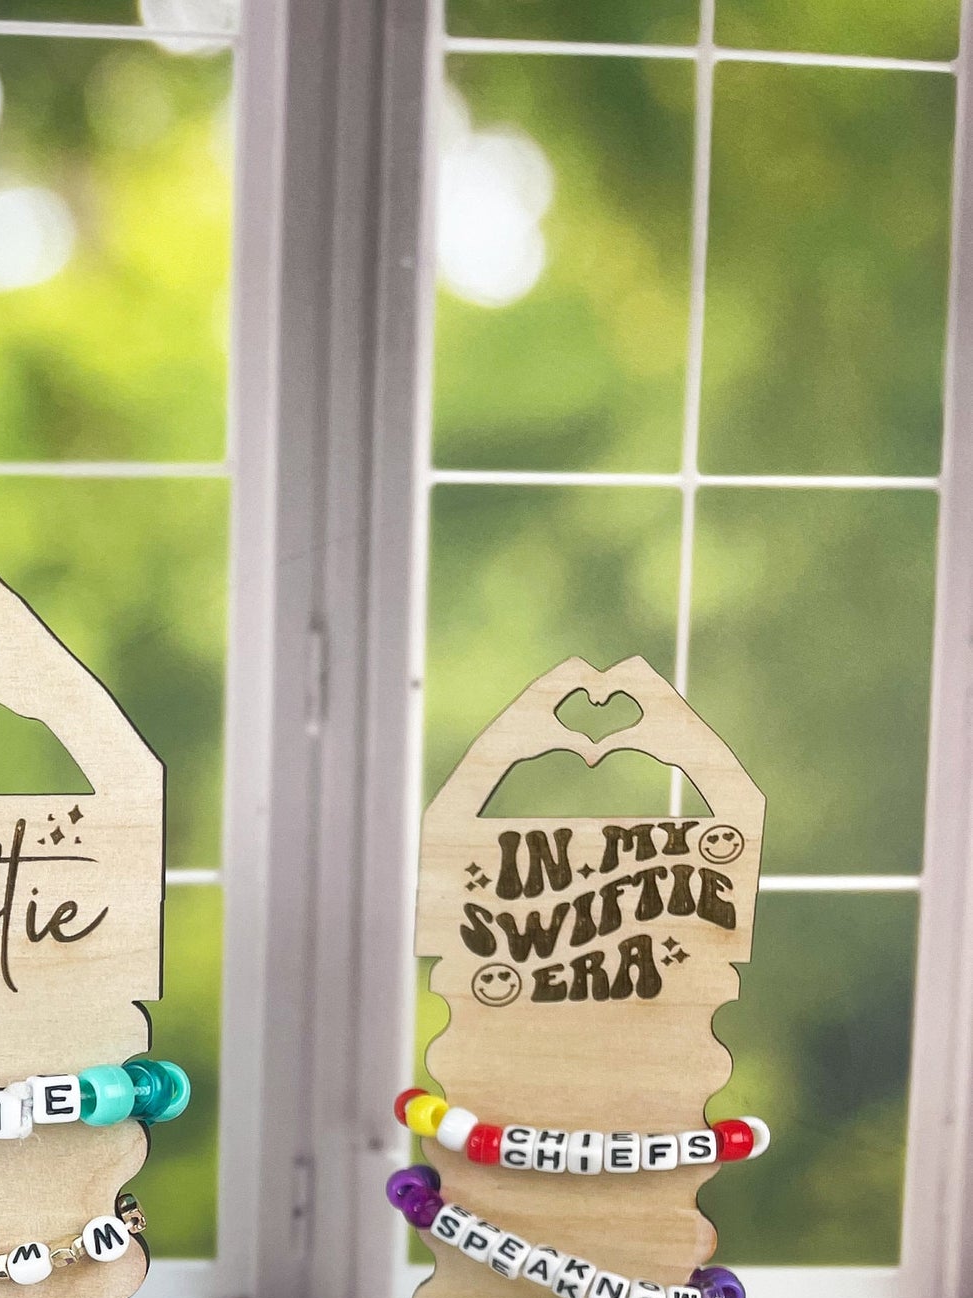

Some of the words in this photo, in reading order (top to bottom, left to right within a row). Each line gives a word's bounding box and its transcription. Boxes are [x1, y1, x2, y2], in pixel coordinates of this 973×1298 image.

[495, 828, 573, 900] IN
[599, 821, 700, 875] MY
[459, 864, 737, 963] SWIFTIE
[530, 934, 663, 1003] ERA
[504, 1136, 712, 1171] CHIEFS
